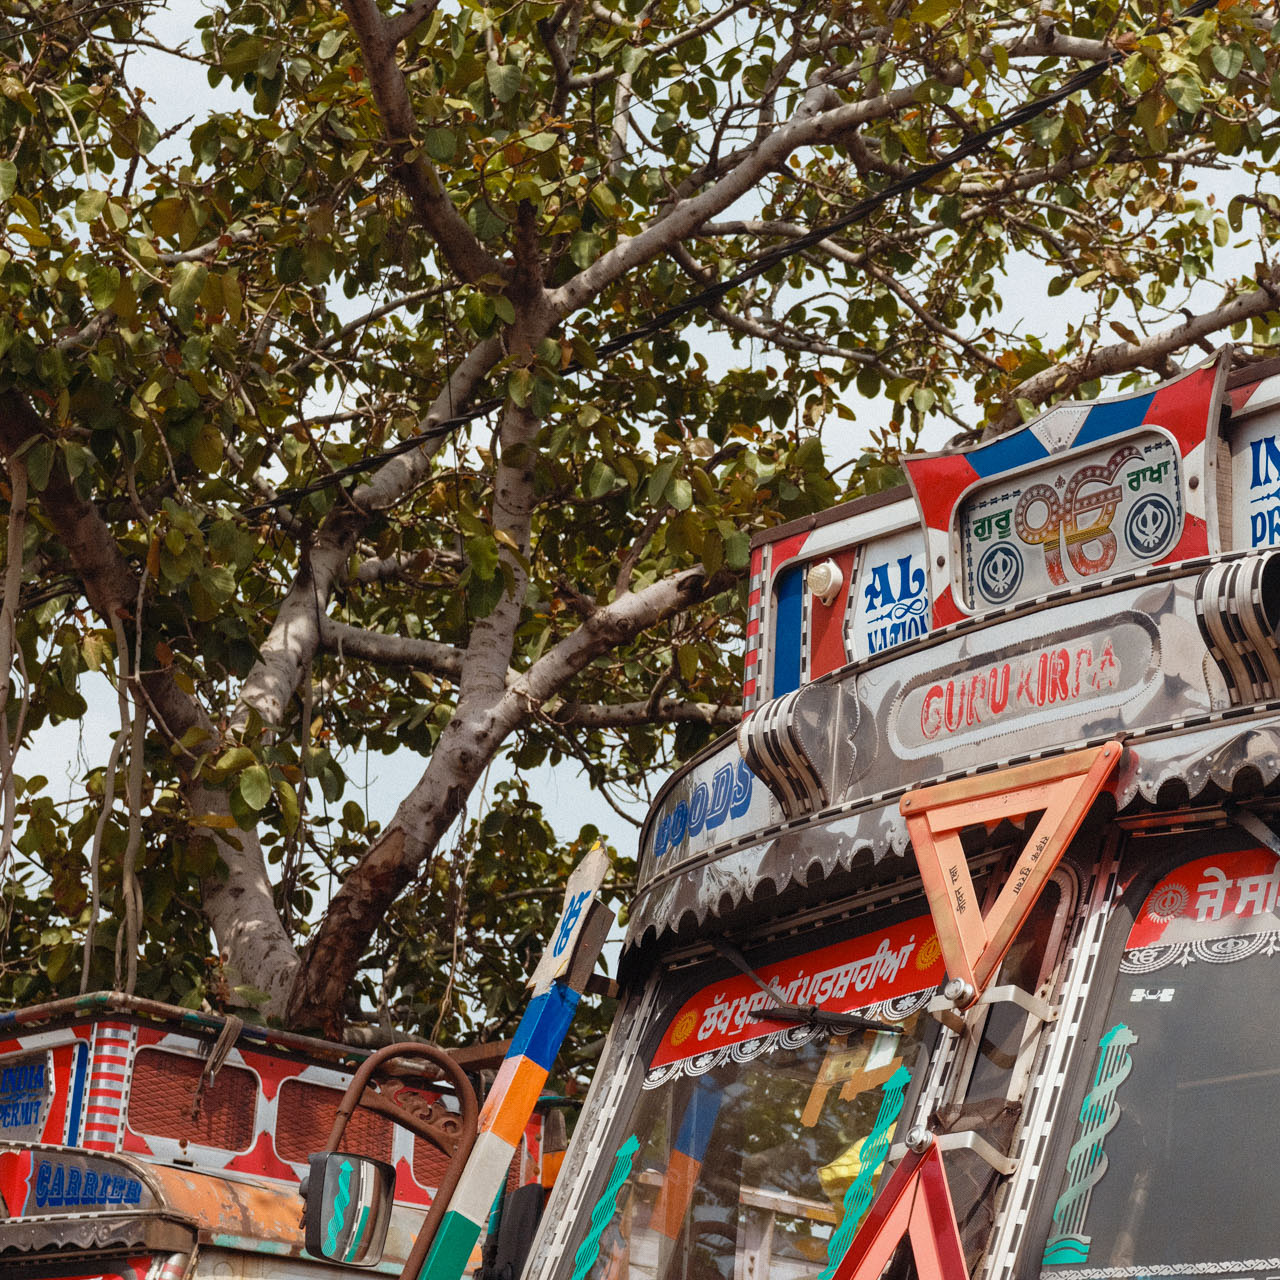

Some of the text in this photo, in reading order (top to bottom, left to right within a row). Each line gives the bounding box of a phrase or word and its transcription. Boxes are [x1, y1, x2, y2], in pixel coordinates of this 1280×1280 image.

[972, 507, 1013, 542] ਗੁਰੂ
[1127, 459, 1171, 493] ਰਾਖਾ
[864, 553, 927, 614] AL
[920, 662, 1012, 741] GURU
[653, 756, 756, 858] GOODS
[949, 865, 967, 914] जीवन रक्षा
[1013, 836, 1049, 895] सड़क सुरक्षा
[0, 1063, 45, 1094] INDIA
[35, 1159, 143, 1208] CARRIER
